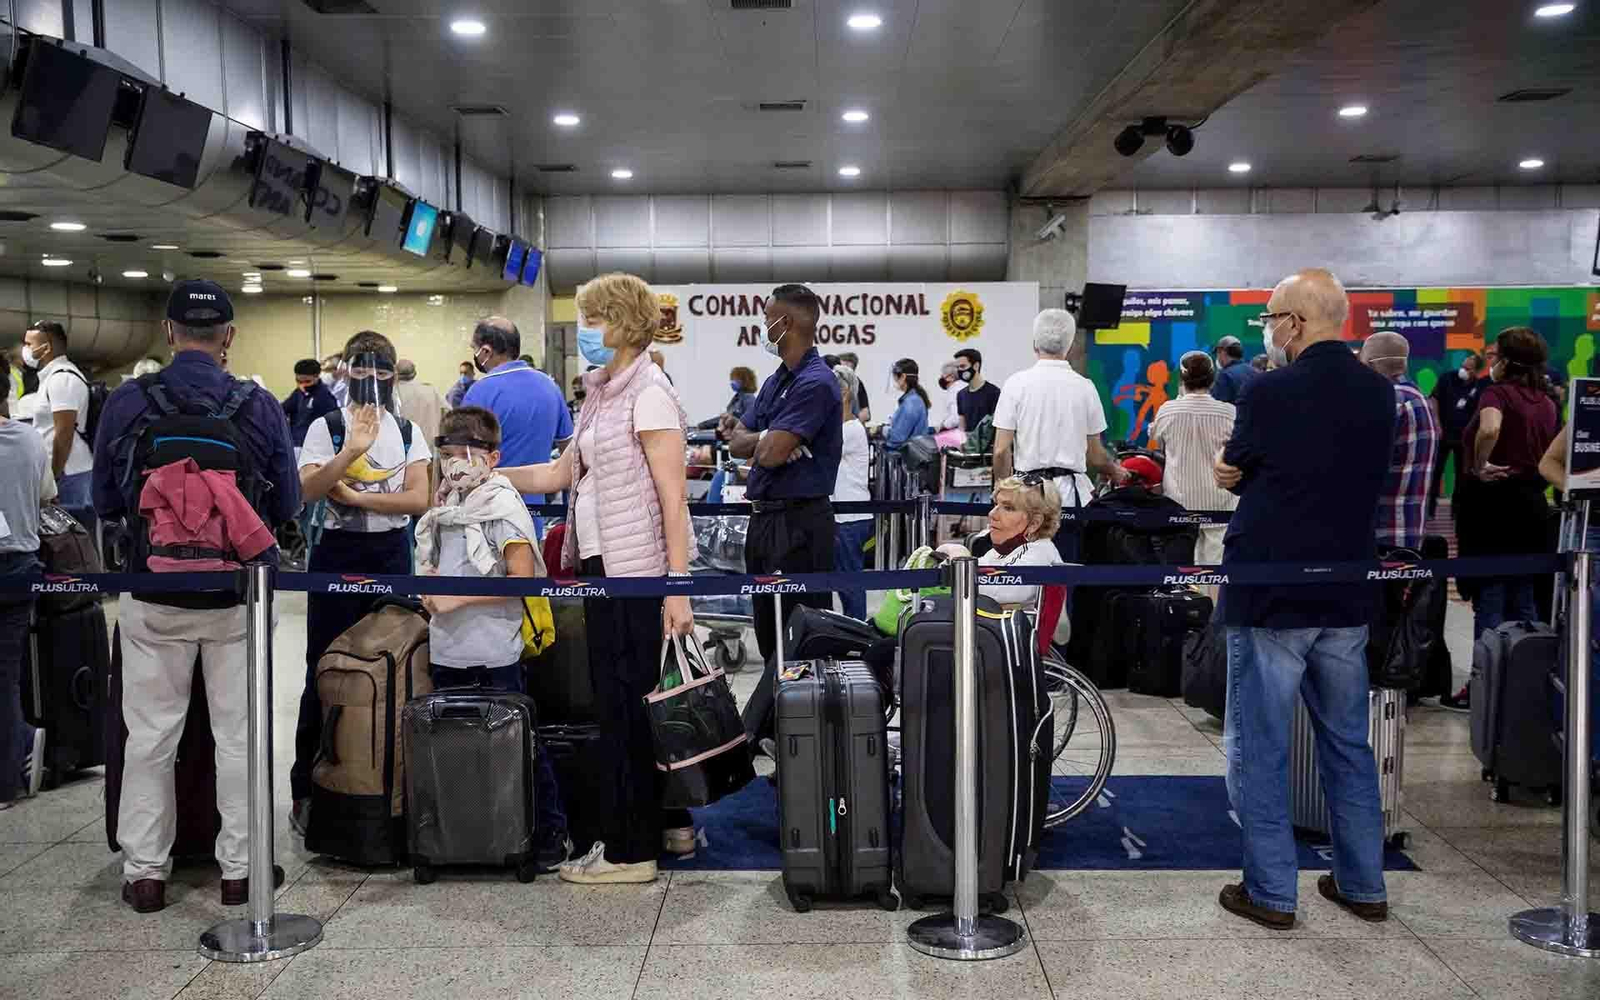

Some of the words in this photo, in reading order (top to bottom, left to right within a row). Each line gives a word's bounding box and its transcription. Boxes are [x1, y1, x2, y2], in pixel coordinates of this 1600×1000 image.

[688, 295, 770, 316] COMAN
[815, 293, 930, 316] NACIONAL
[1574, 442, 1600, 453] BUSINE
[1163, 575, 1229, 584] PLUSULTRA
[1367, 569, 1433, 580] PLUSULTRA
[977, 575, 1023, 585] SULTRA
[31, 583, 99, 592] PLUSULTRA
[328, 583, 393, 594] PLUSULTRA
[541, 587, 606, 596] PLUSULTRA
[741, 584, 807, 593] PLUSULTRA
